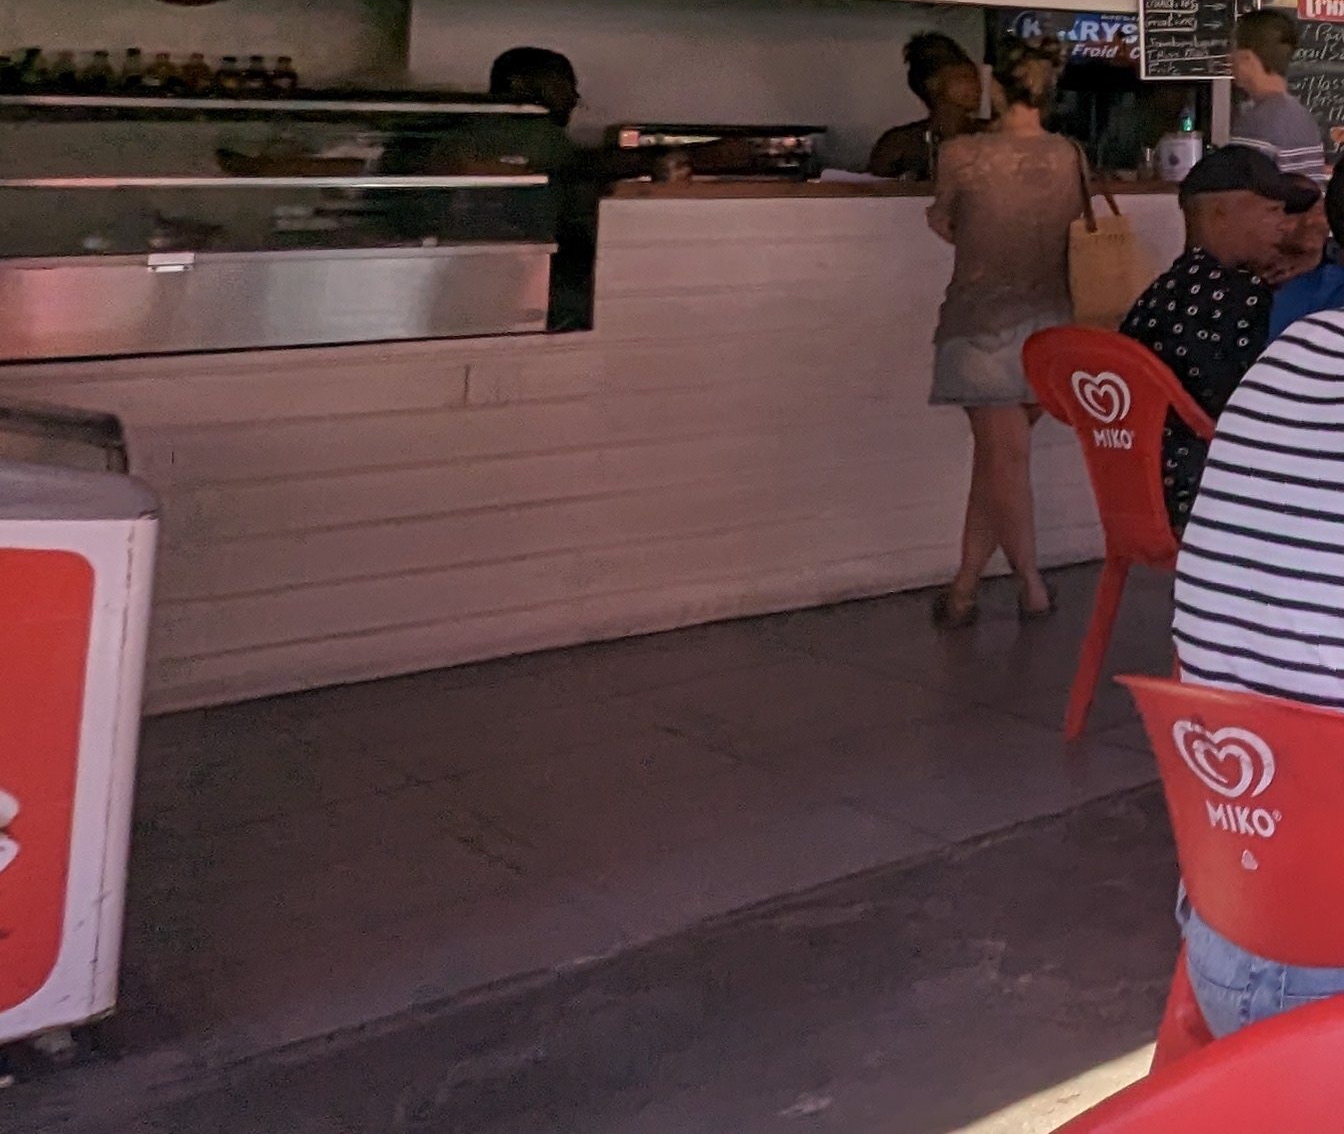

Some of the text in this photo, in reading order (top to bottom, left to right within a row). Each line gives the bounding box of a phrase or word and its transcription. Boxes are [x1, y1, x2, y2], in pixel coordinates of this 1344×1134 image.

[1072, 44, 1119, 59] Froid
[1093, 427, 1133, 450] MIKO
[1205, 799, 1276, 838] MIKO
